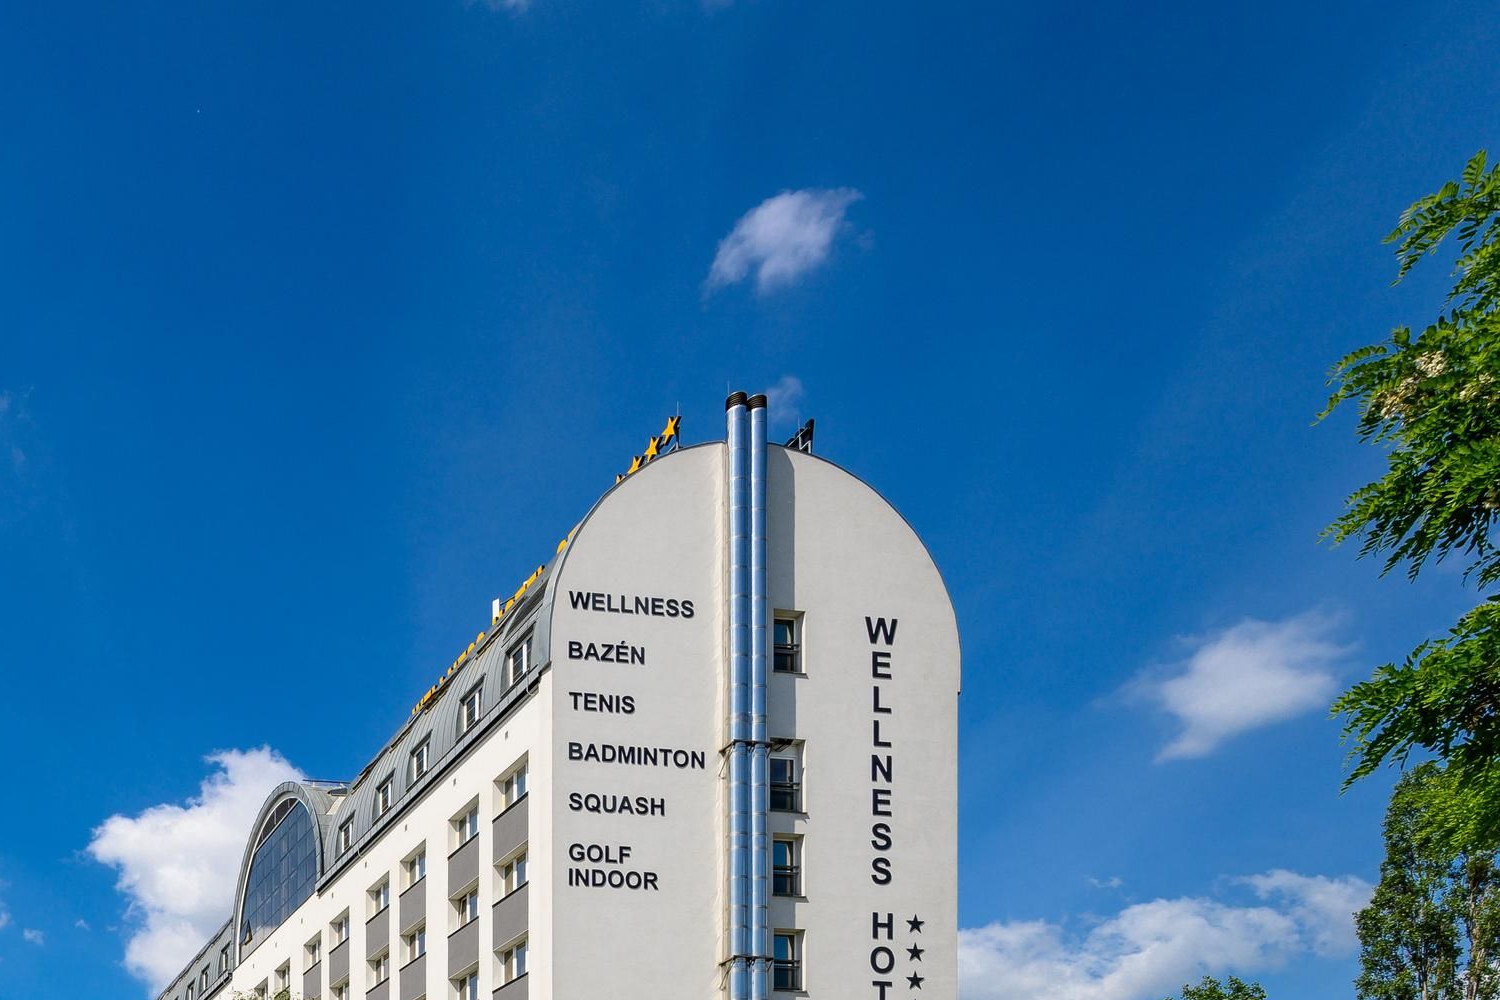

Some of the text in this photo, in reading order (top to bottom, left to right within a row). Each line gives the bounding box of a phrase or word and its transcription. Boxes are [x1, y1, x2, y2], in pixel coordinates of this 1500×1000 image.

[568, 591, 695, 618] WELLNESS
[568, 641, 645, 665] BAZÉN
[568, 692, 636, 714] TENIS
[568, 743, 706, 770] BADMINTON
[865, 616, 898, 886] WELLNESS
[568, 793, 665, 816] SQUASH
[568, 844, 632, 864] GOLF
[568, 869, 659, 890] INDOOR
